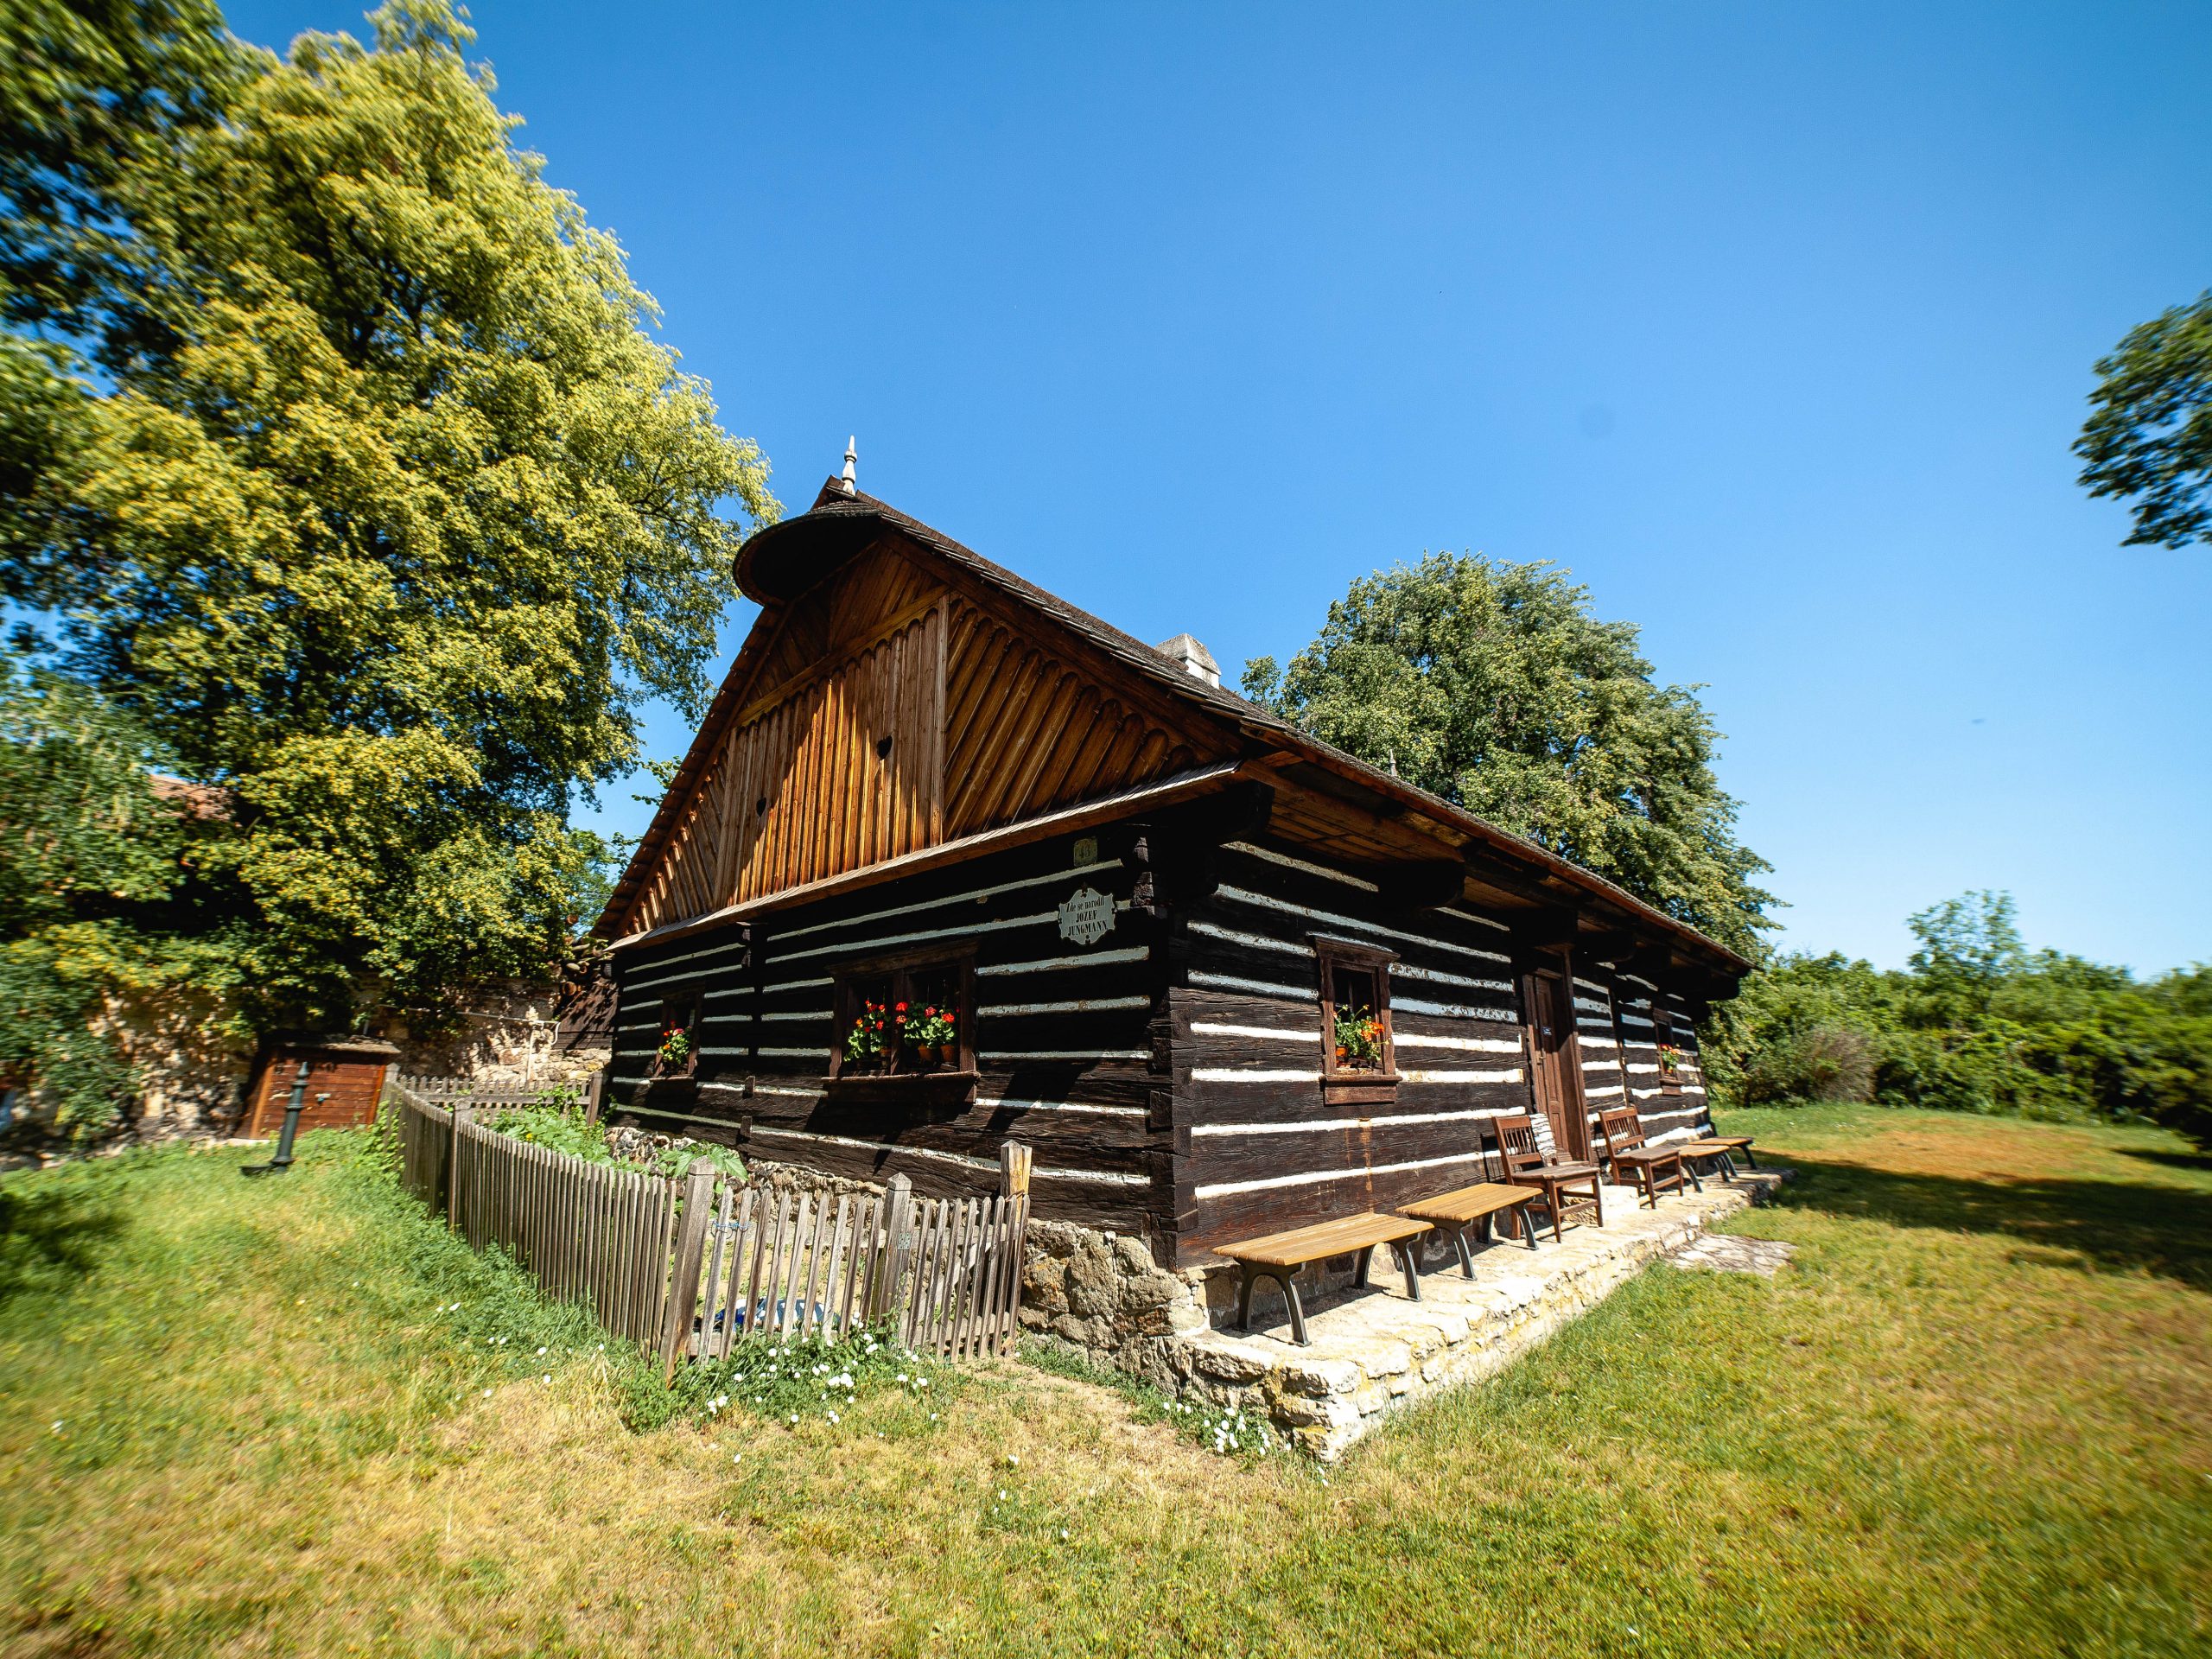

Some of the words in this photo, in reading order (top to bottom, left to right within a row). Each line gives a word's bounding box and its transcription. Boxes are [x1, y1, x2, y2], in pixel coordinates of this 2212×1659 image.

[1085, 896, 1104, 909] narodil
[1076, 909, 1097, 923] JOZEF
[1068, 920, 1107, 936] JUNGMANN
